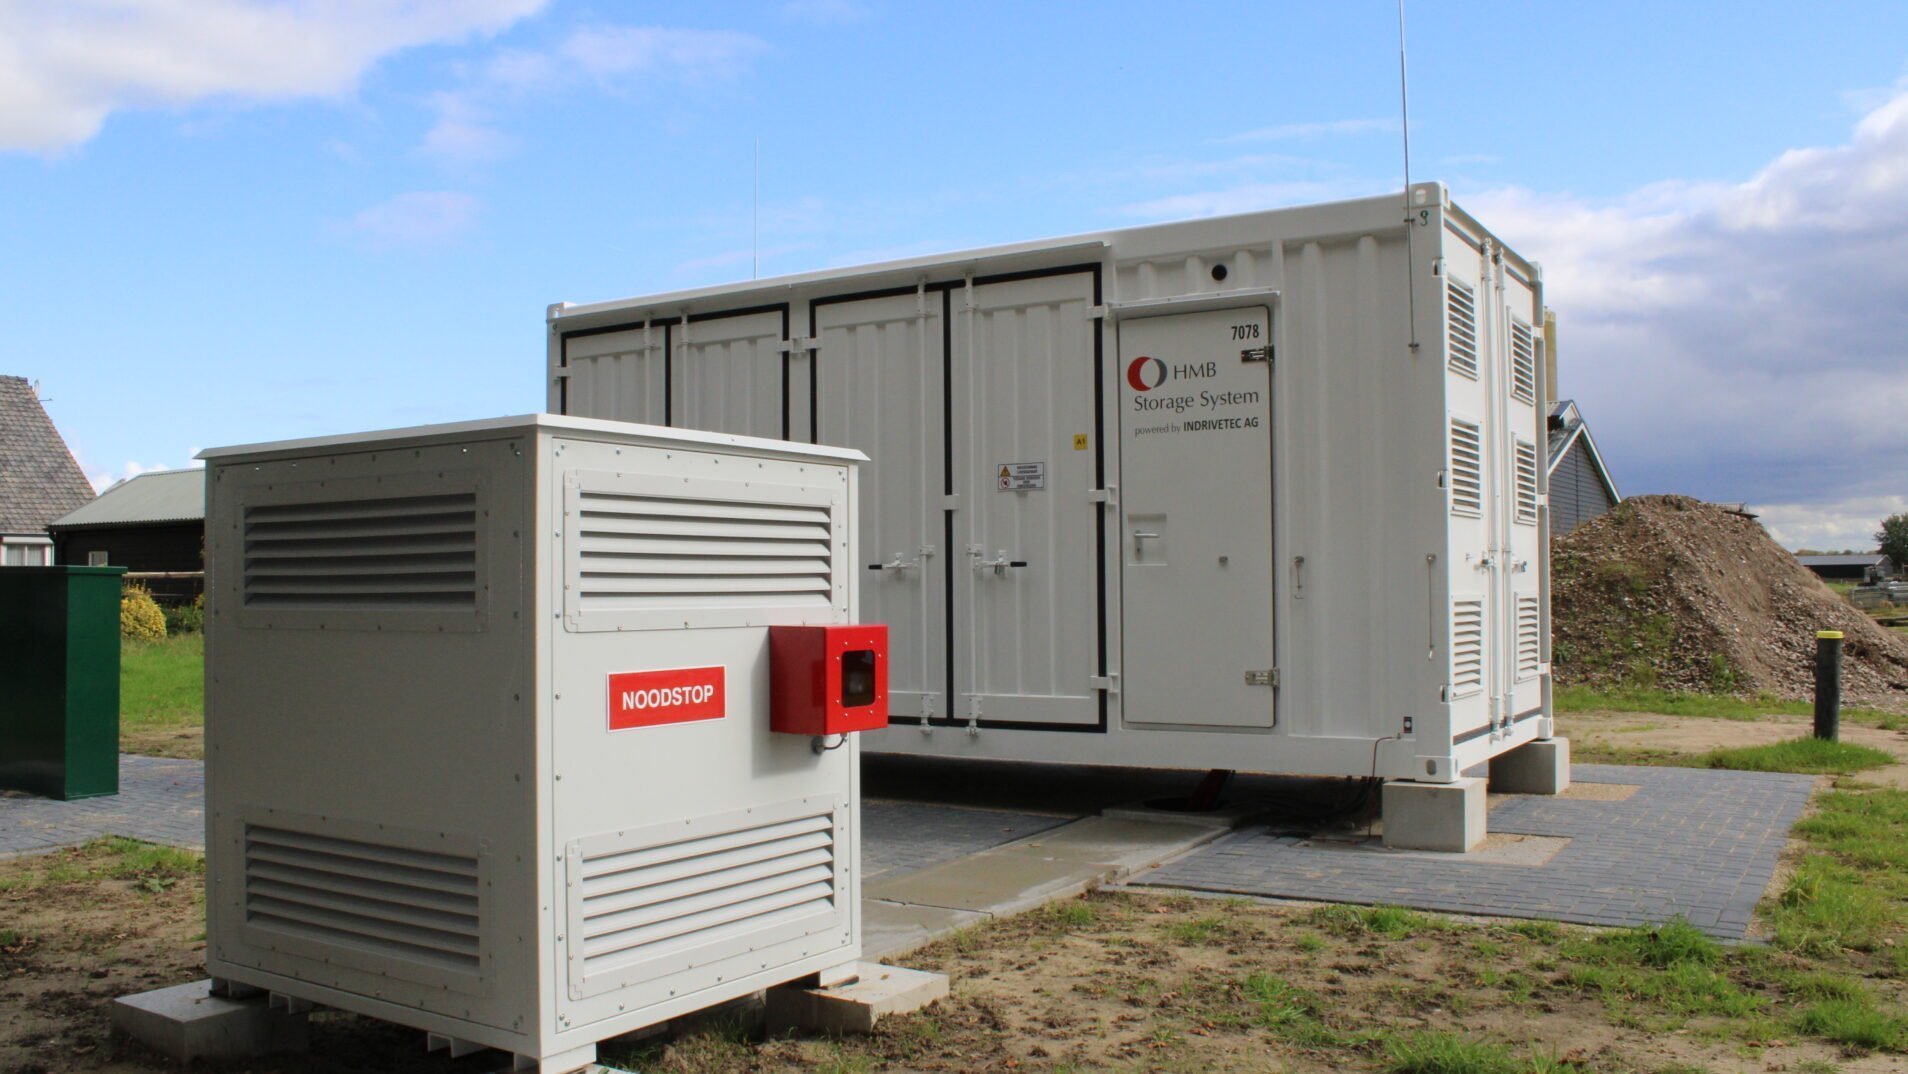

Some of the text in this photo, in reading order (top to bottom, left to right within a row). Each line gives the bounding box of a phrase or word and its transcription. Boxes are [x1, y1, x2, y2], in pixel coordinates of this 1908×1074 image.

[1231, 324, 1260, 340] 7078
[1173, 361, 1217, 380] HMB
[1134, 391, 1259, 413] Storage System
[1135, 417, 1259, 437] powered by INDRIVETEC AG
[622, 685, 714, 710] NOODSTOP
